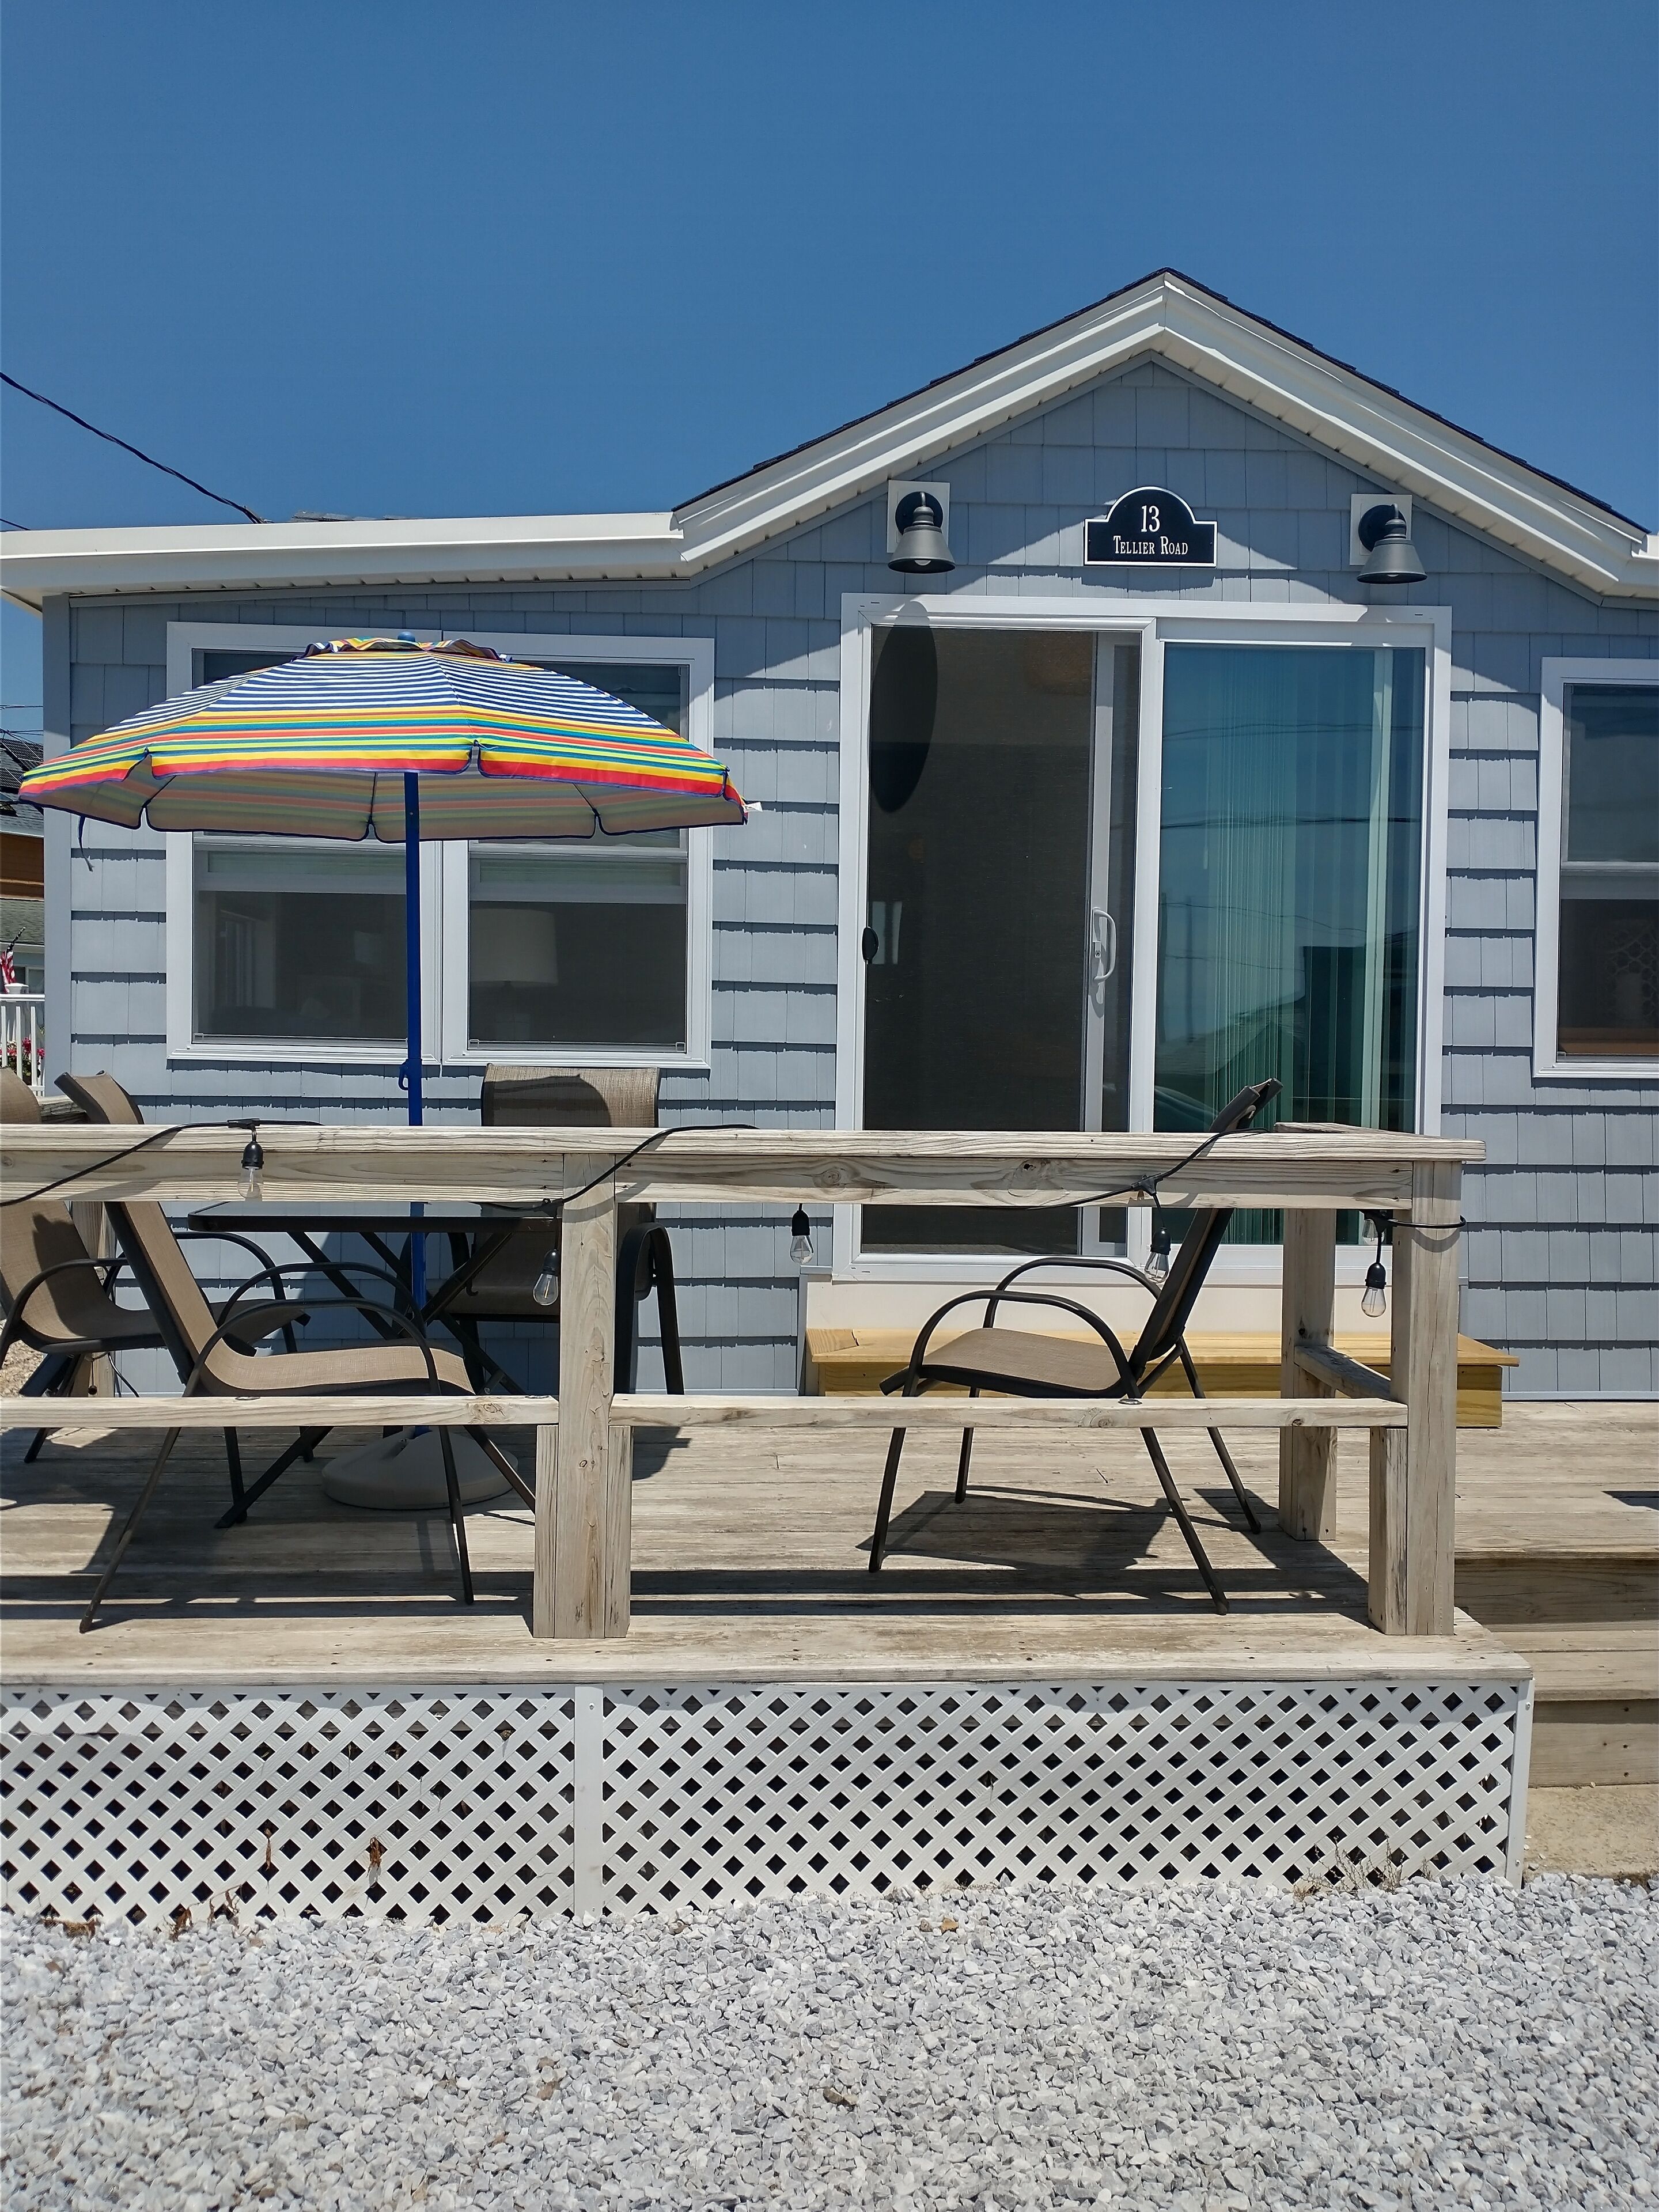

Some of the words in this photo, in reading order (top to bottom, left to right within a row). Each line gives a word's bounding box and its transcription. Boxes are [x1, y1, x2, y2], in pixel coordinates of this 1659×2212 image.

[1141, 505, 1160, 532] 13
[1113, 535, 1155, 554] TELLIER
[1160, 536, 1188, 555] ROAD
